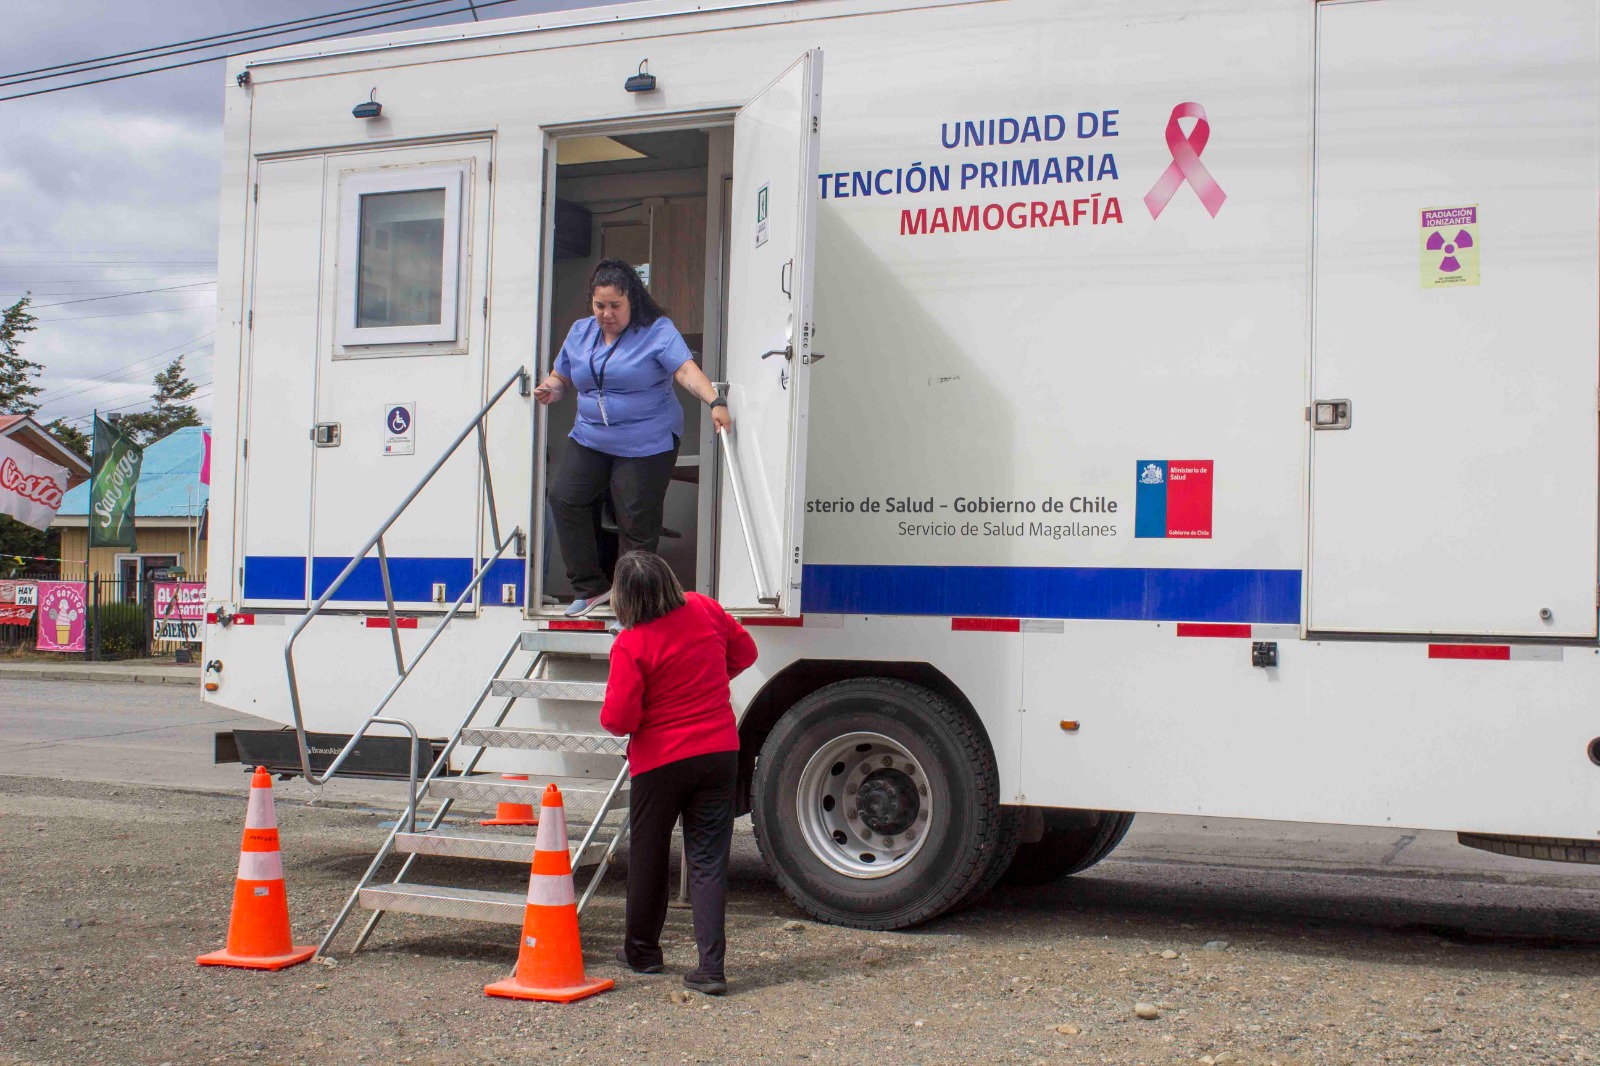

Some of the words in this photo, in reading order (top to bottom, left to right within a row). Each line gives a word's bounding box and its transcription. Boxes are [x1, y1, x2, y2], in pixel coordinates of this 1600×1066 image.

[942, 113, 1066, 149] UNIDAD
[1077, 109, 1120, 139] DE
[816, 161, 950, 199] TENCIÓN
[960, 153, 1120, 190] PRIMARIA
[899, 193, 1124, 236] MAMOGRAFÍA
[1425, 208, 1473, 220] RADIACIÓN
[1426, 216, 1472, 226] IONIZANTE
[805, 497, 855, 513] sterio
[859, 497, 881, 513] de
[885, 497, 934, 513] Salud
[954, 497, 1036, 513] Gobierno
[1041, 497, 1064, 513] de
[1069, 497, 1118, 513] Chile
[898, 521, 956, 536] Servicio
[960, 522, 979, 536] de
[983, 521, 1024, 536] Salud
[1029, 522, 1117, 540] Magallanes
[18, 586, 34, 595] HAY
[43, 594, 55, 611] LOS
[56, 590, 84, 614] GATITOS
[155, 621, 197, 638] ABIERTO
